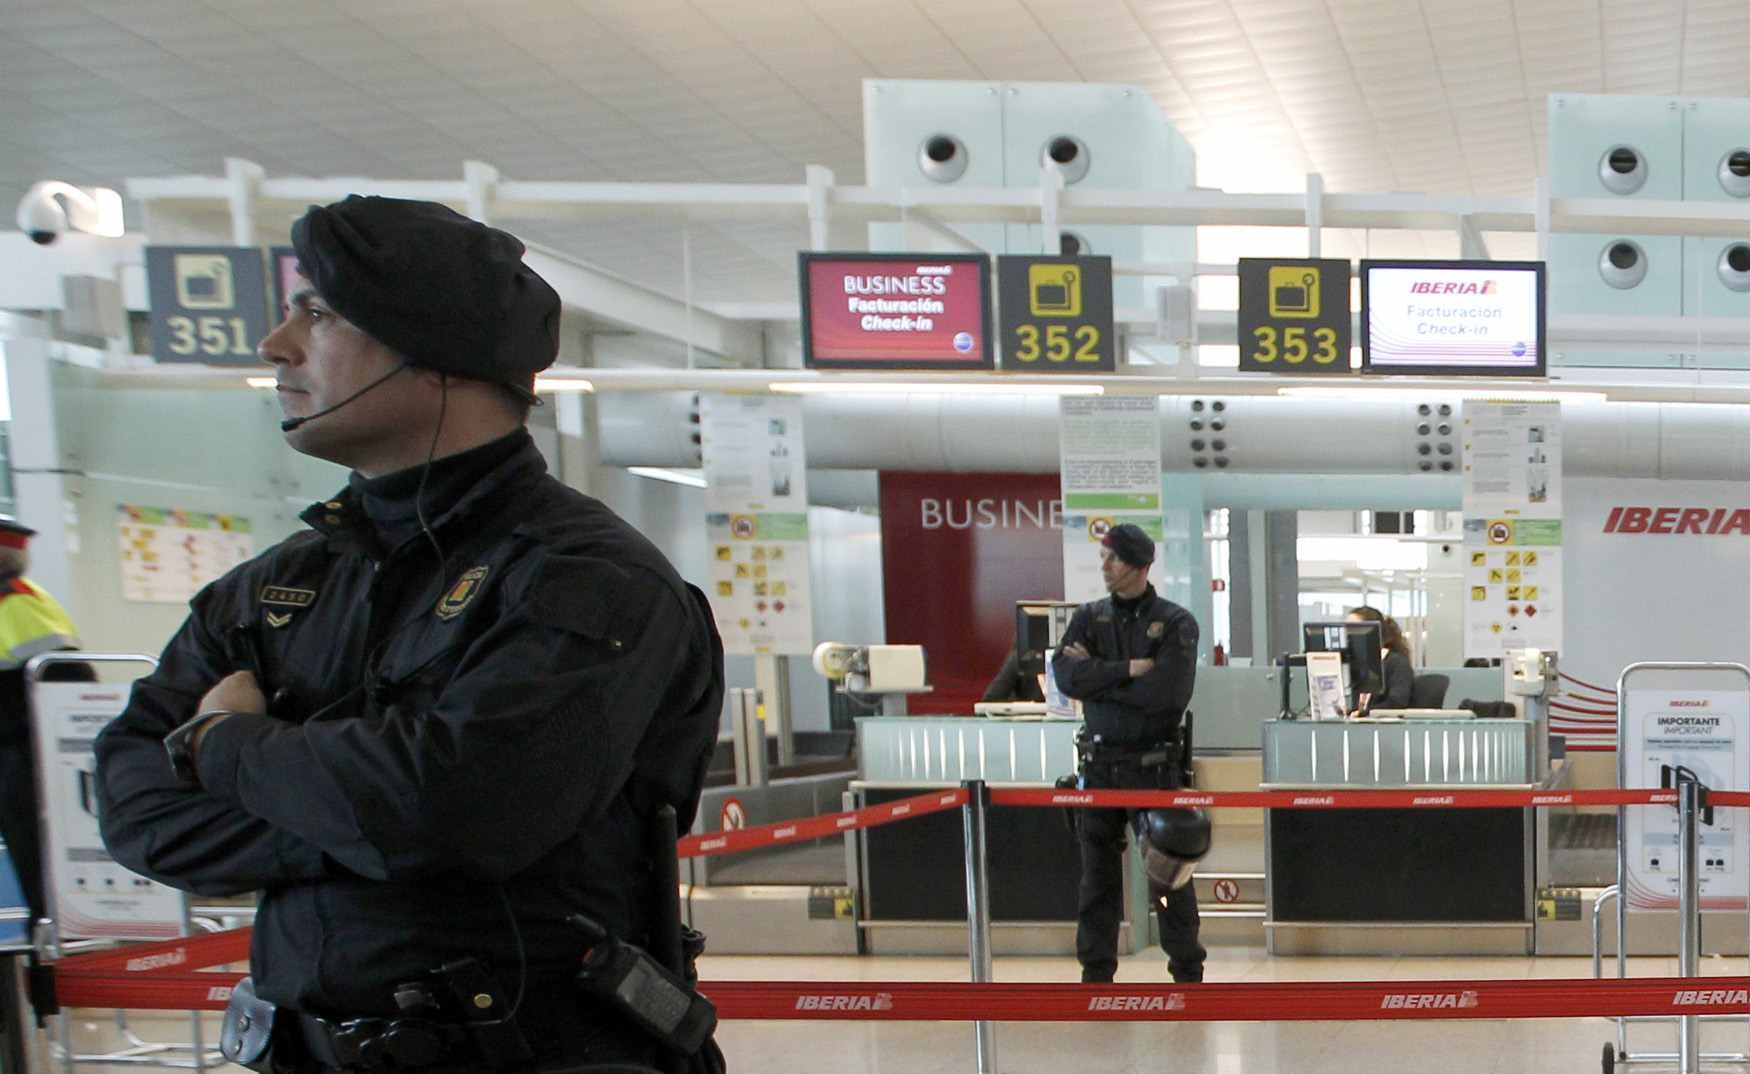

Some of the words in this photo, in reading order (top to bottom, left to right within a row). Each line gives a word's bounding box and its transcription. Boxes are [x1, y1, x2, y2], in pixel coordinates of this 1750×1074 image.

[844, 276, 946, 295] BUSINESS
[1410, 281, 1479, 294] IBERIA
[848, 297, 944, 313] Facturación
[861, 315, 933, 331] Check-in
[1417, 323, 1489, 336] Check-in
[166, 316, 255, 355] 351
[1015, 324, 1100, 362] 352
[1253, 325, 1337, 364] 353
[921, 498, 1063, 529] BUSINE
[1657, 717, 1721, 726] IMPORTANTE
[795, 996, 875, 1010] IBERIA
[1088, 996, 1165, 1010] IBERIA
[1381, 994, 1457, 1009] IBERIA
[1673, 990, 1749, 1006] IBERIA
